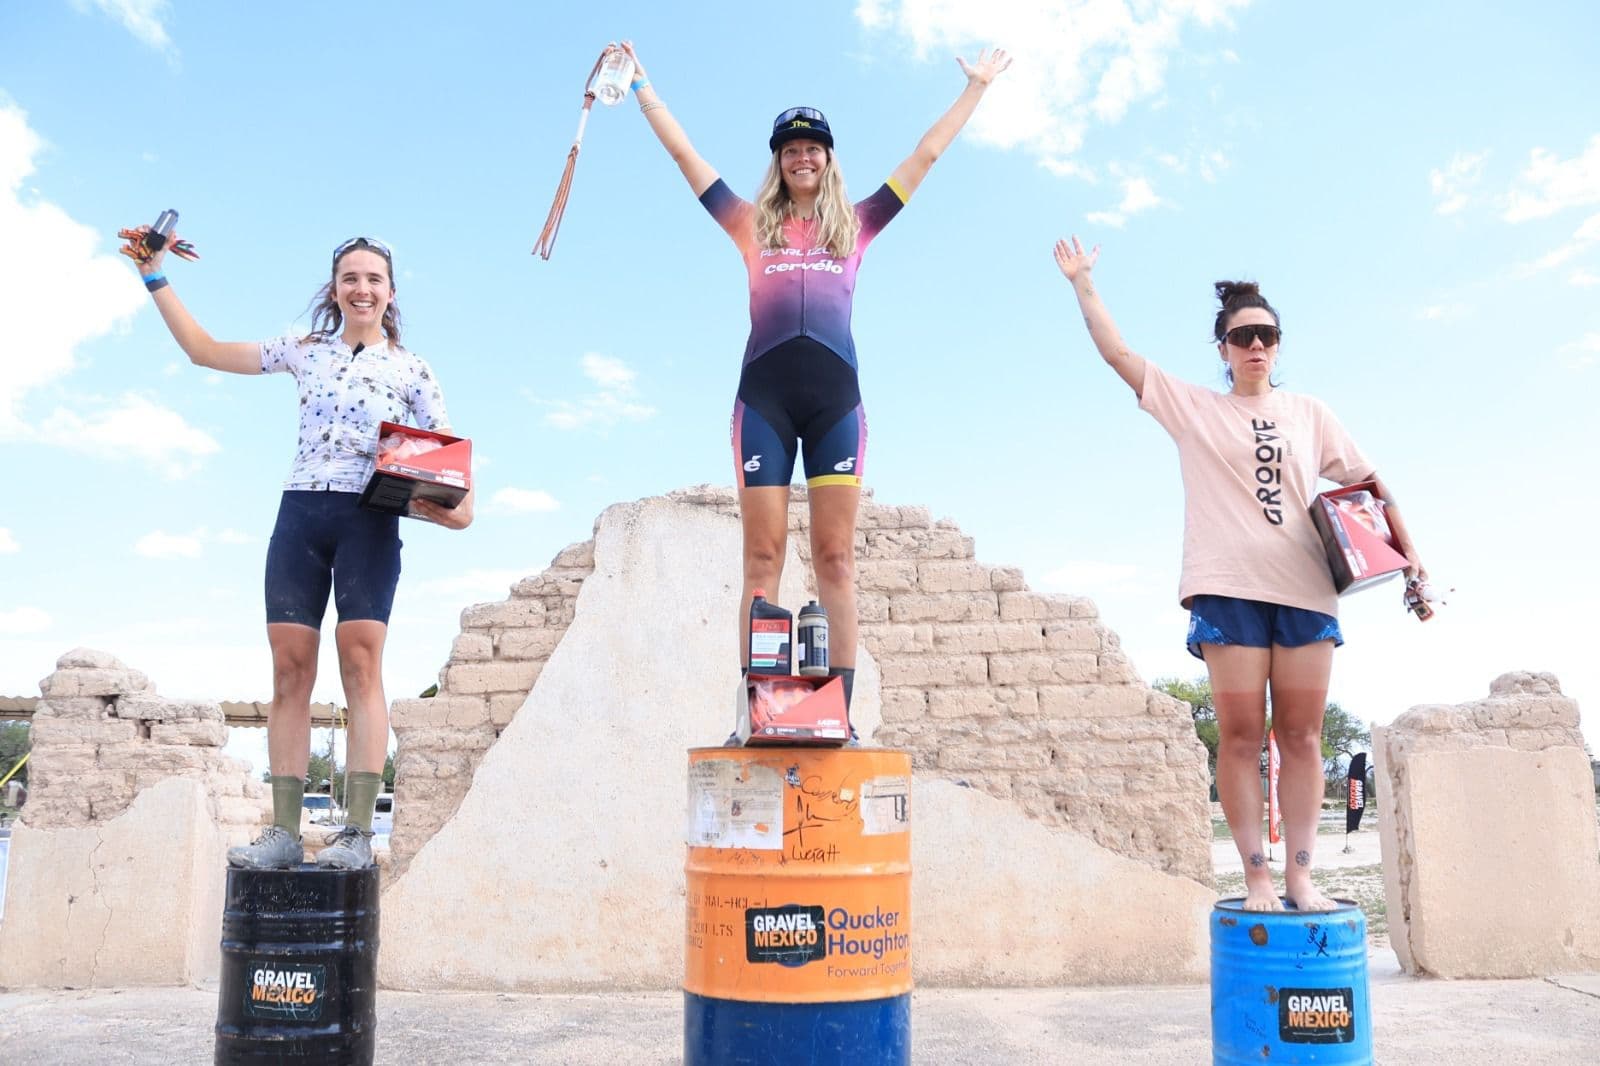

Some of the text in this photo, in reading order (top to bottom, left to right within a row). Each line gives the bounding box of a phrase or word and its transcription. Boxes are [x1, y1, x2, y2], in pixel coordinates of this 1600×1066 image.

[765, 259, 843, 275] cervélo
[1252, 418, 1284, 526] GROOVE
[753, 913, 816, 932] GRAVEL
[828, 905, 899, 930] Quaker
[754, 929, 818, 947] MEXICO
[828, 929, 909, 960] Houghton
[254, 969, 315, 989] GRAVEL
[827, 965, 878, 977] Forward
[252, 984, 317, 1004] MEXICO
[1288, 995, 1347, 1012] GRAVEL
[1288, 1011, 1349, 1028] MEXICO
